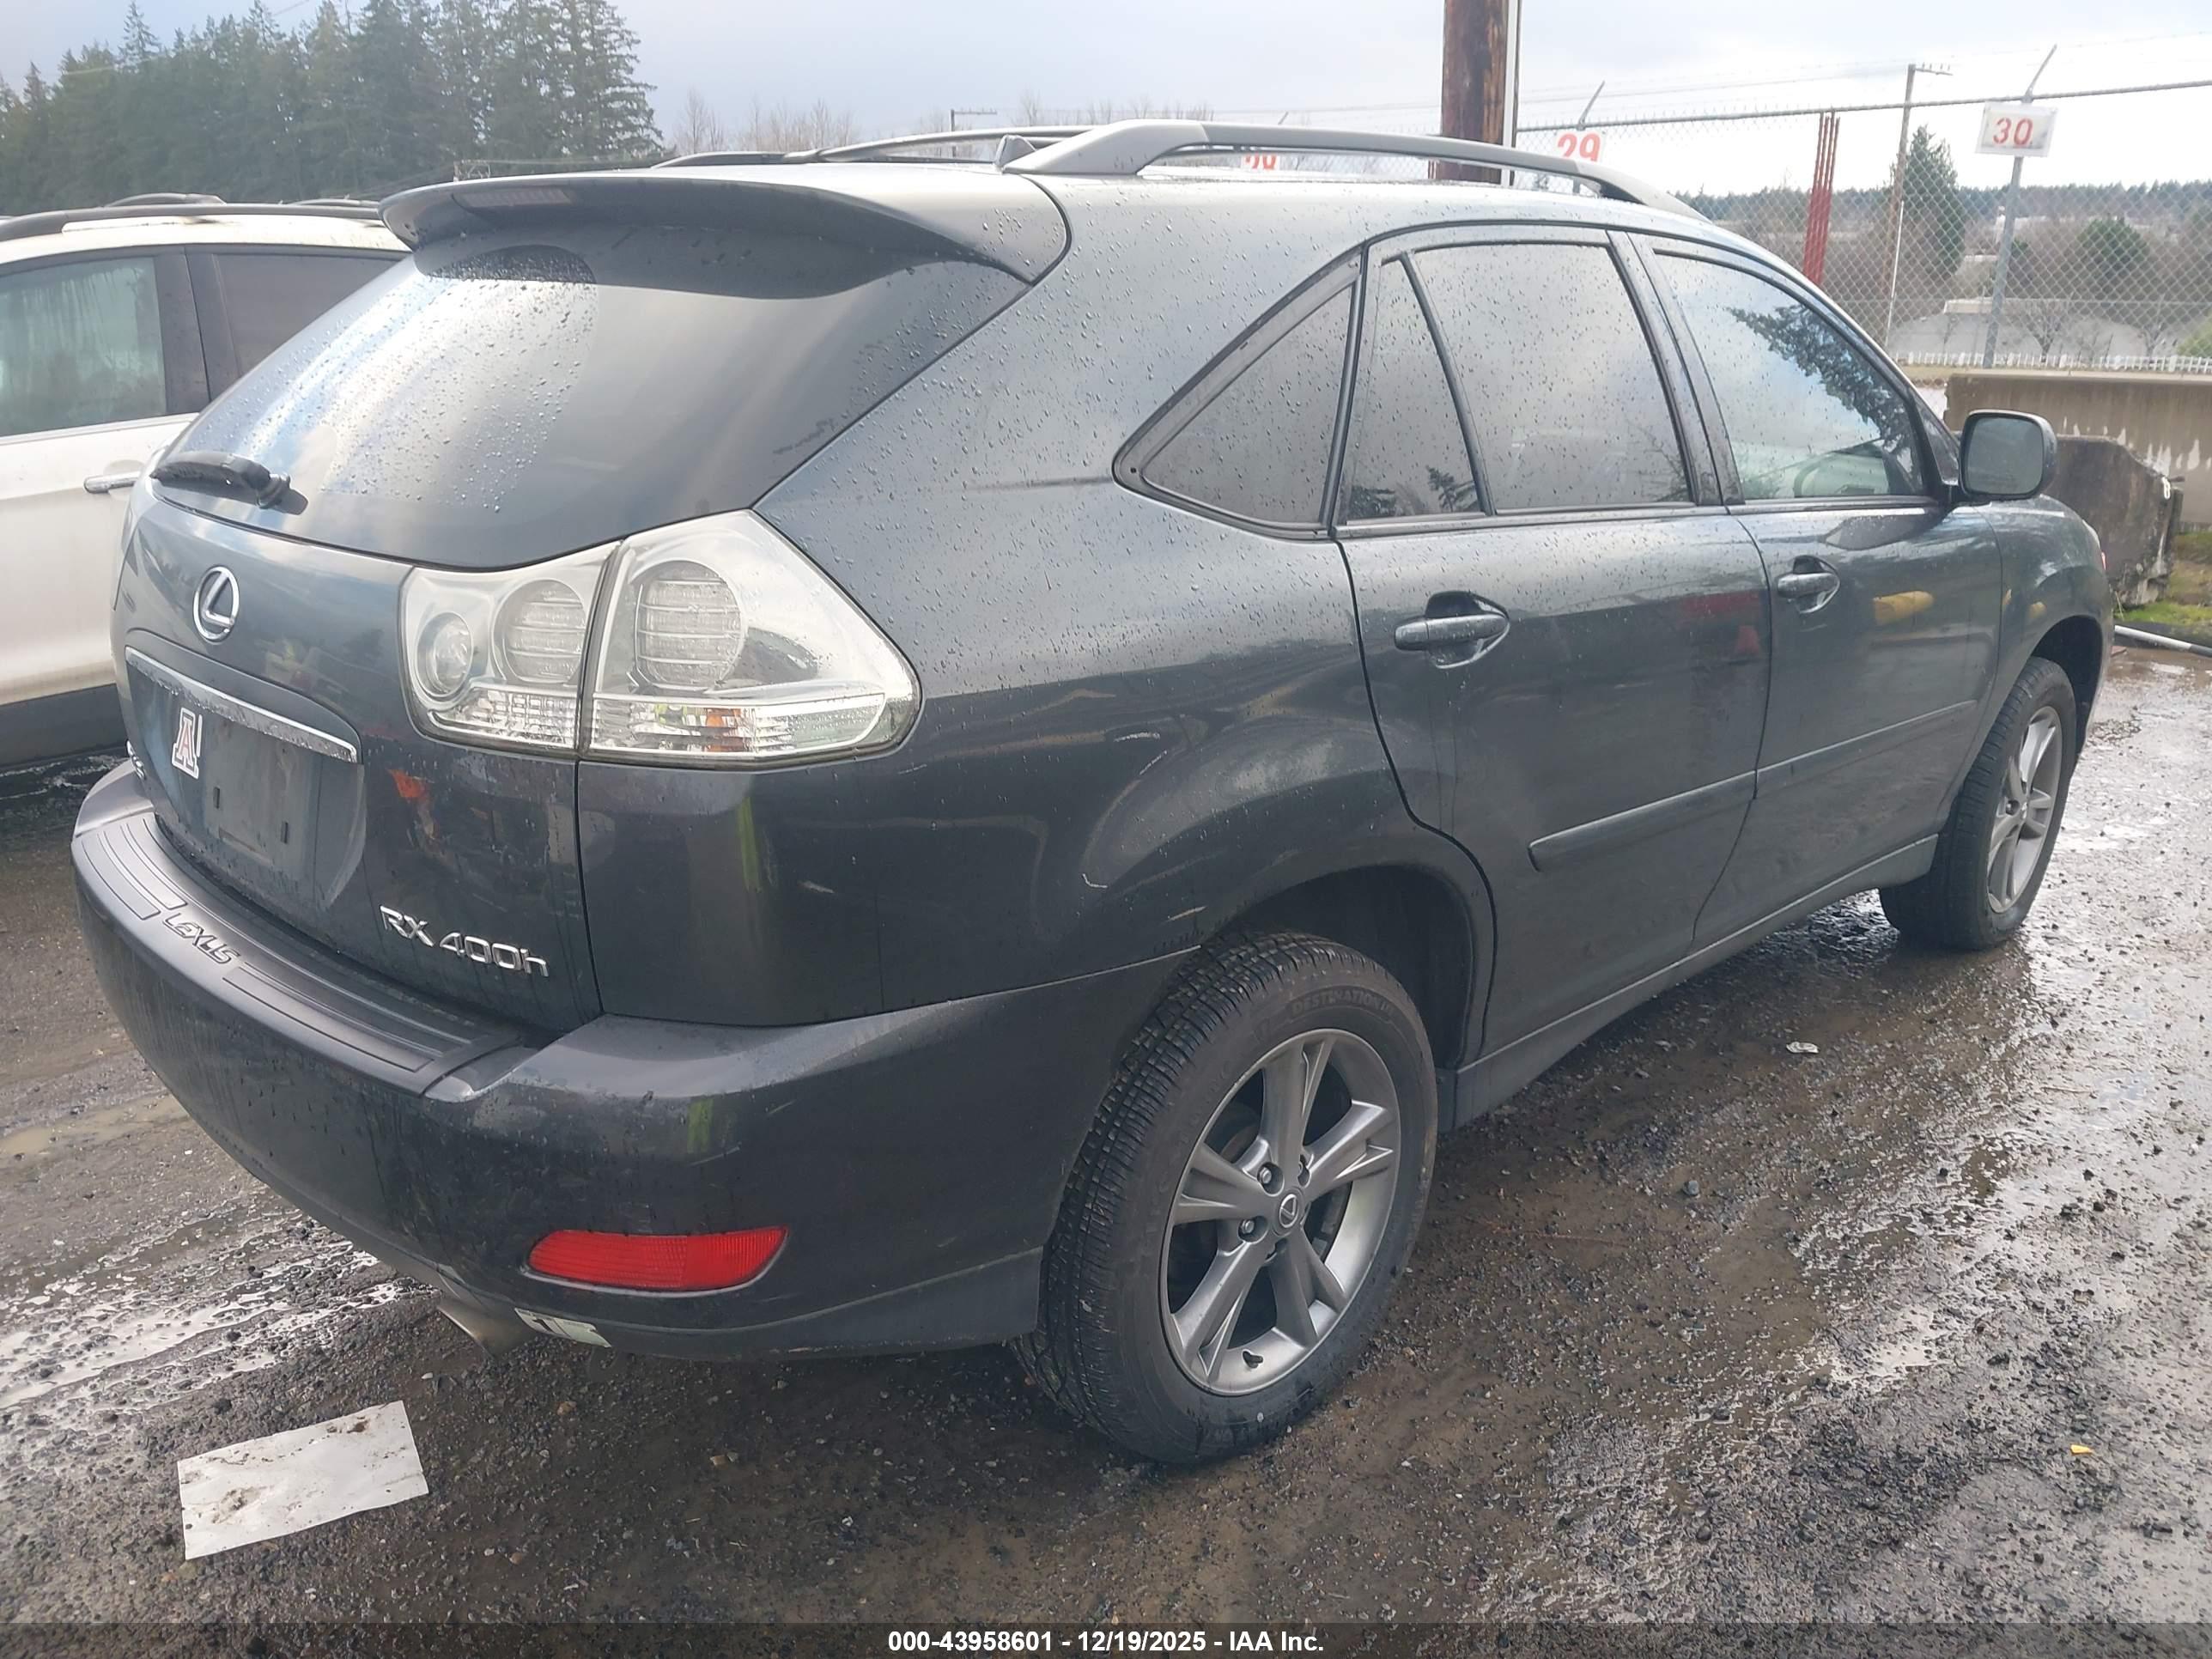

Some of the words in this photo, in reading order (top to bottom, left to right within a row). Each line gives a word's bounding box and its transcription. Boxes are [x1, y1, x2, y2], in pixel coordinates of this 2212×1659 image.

[1993, 118, 2033, 145] 30
[1558, 133, 1601, 161] 29
[380, 905, 434, 947] RX
[439, 932, 549, 977] 400h
